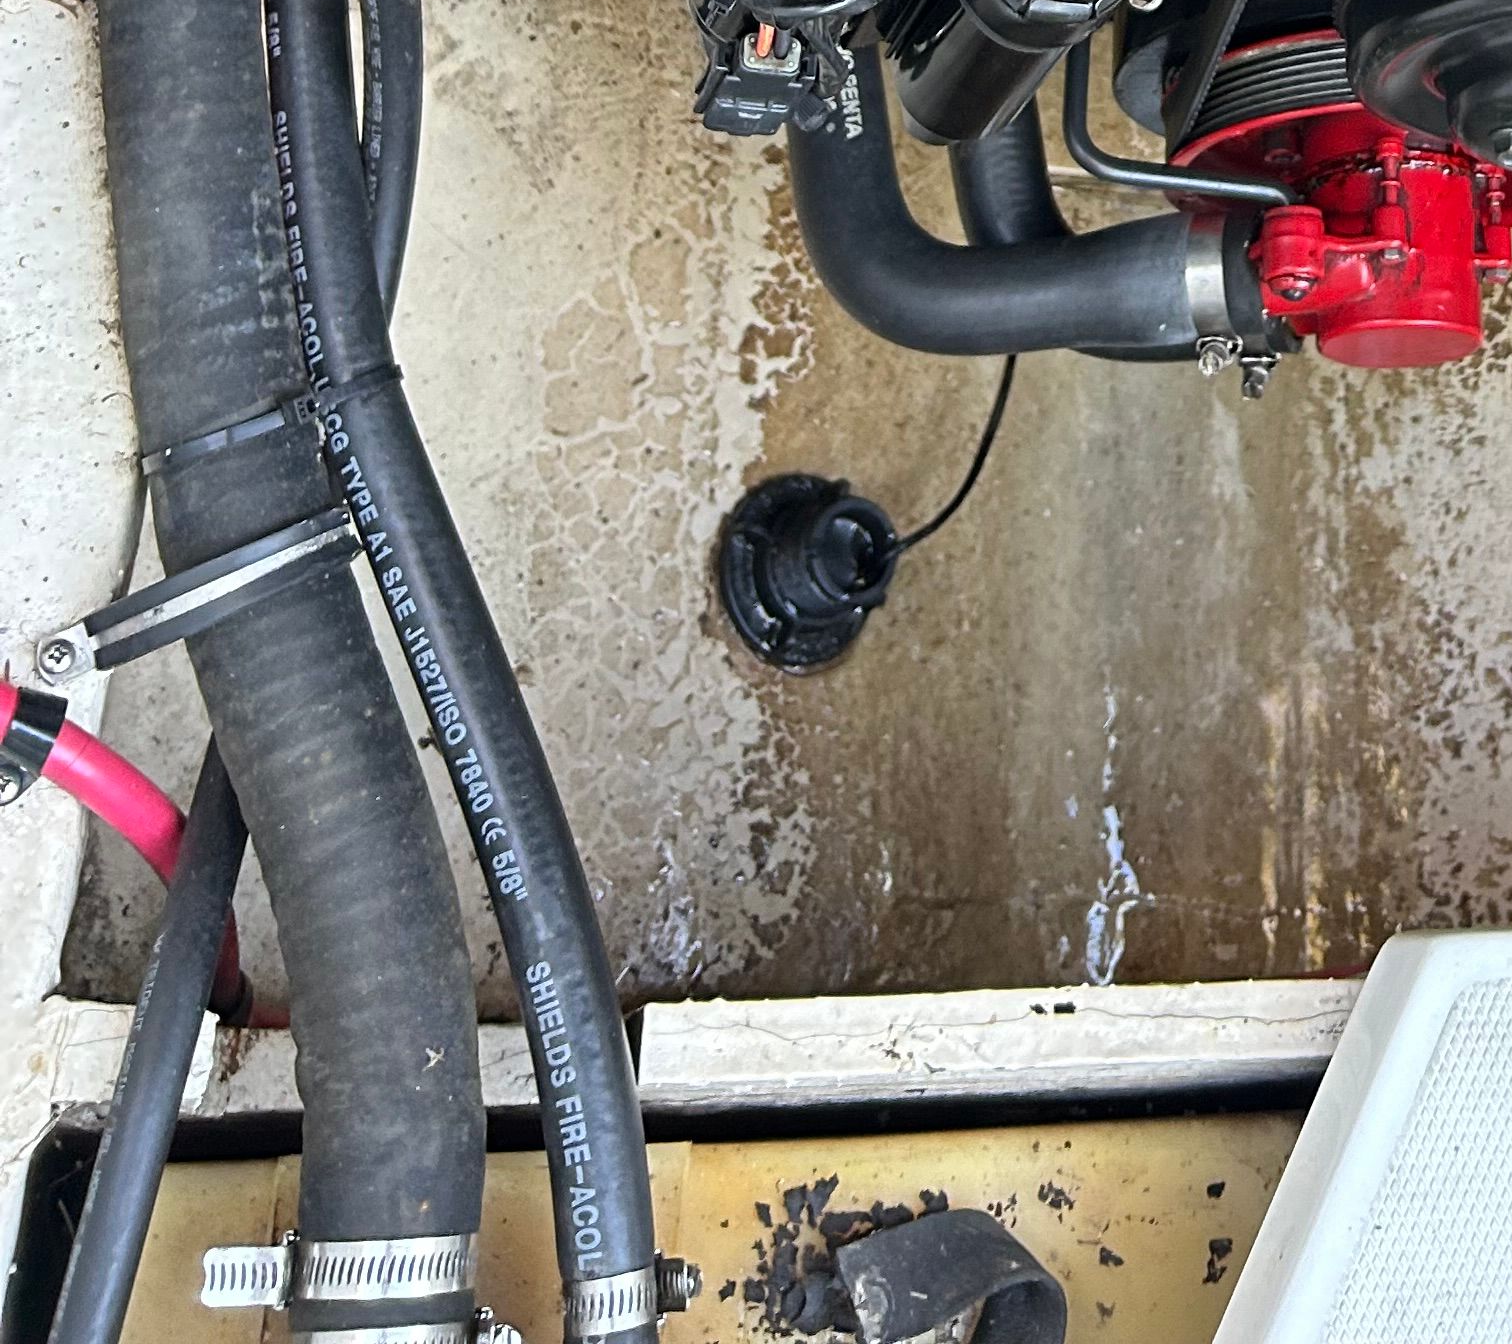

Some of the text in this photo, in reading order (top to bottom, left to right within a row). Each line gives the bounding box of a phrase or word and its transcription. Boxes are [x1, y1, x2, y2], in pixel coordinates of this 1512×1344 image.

[840, 73, 864, 140] PENTA
[338, 456, 380, 531] TYPE
[367, 531, 394, 562] A1
[381, 566, 418, 625] SAE
[403, 627, 467, 746] J1527/ISO
[453, 748, 496, 814] 7840
[492, 851, 529, 903] 5/8"
[525, 960, 605, 1272] SHIELDS FIRE-ACOL
